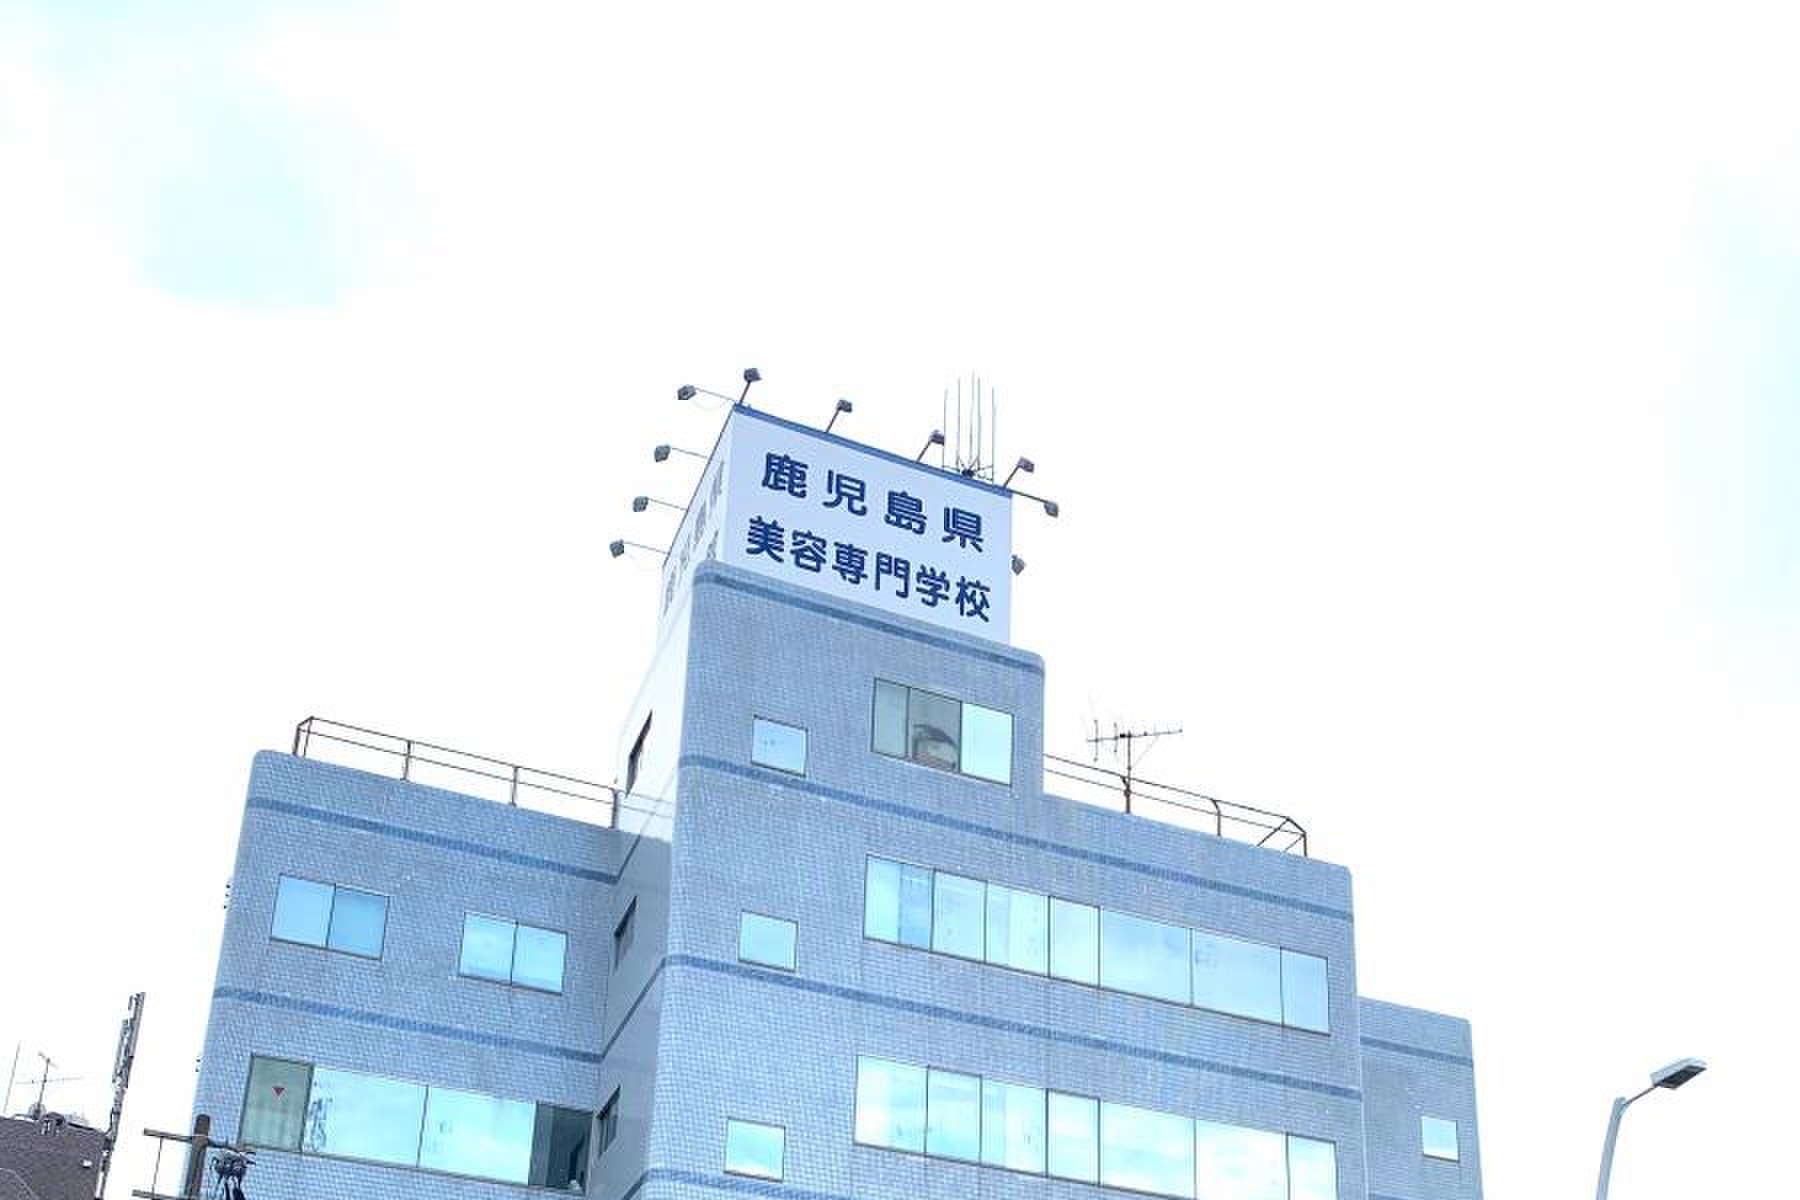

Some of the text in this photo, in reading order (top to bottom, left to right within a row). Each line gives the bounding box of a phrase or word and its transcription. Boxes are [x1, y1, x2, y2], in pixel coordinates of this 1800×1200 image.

[762, 452, 984, 553] 鹿児島県
[746, 515, 991, 622] 美容専門学校
